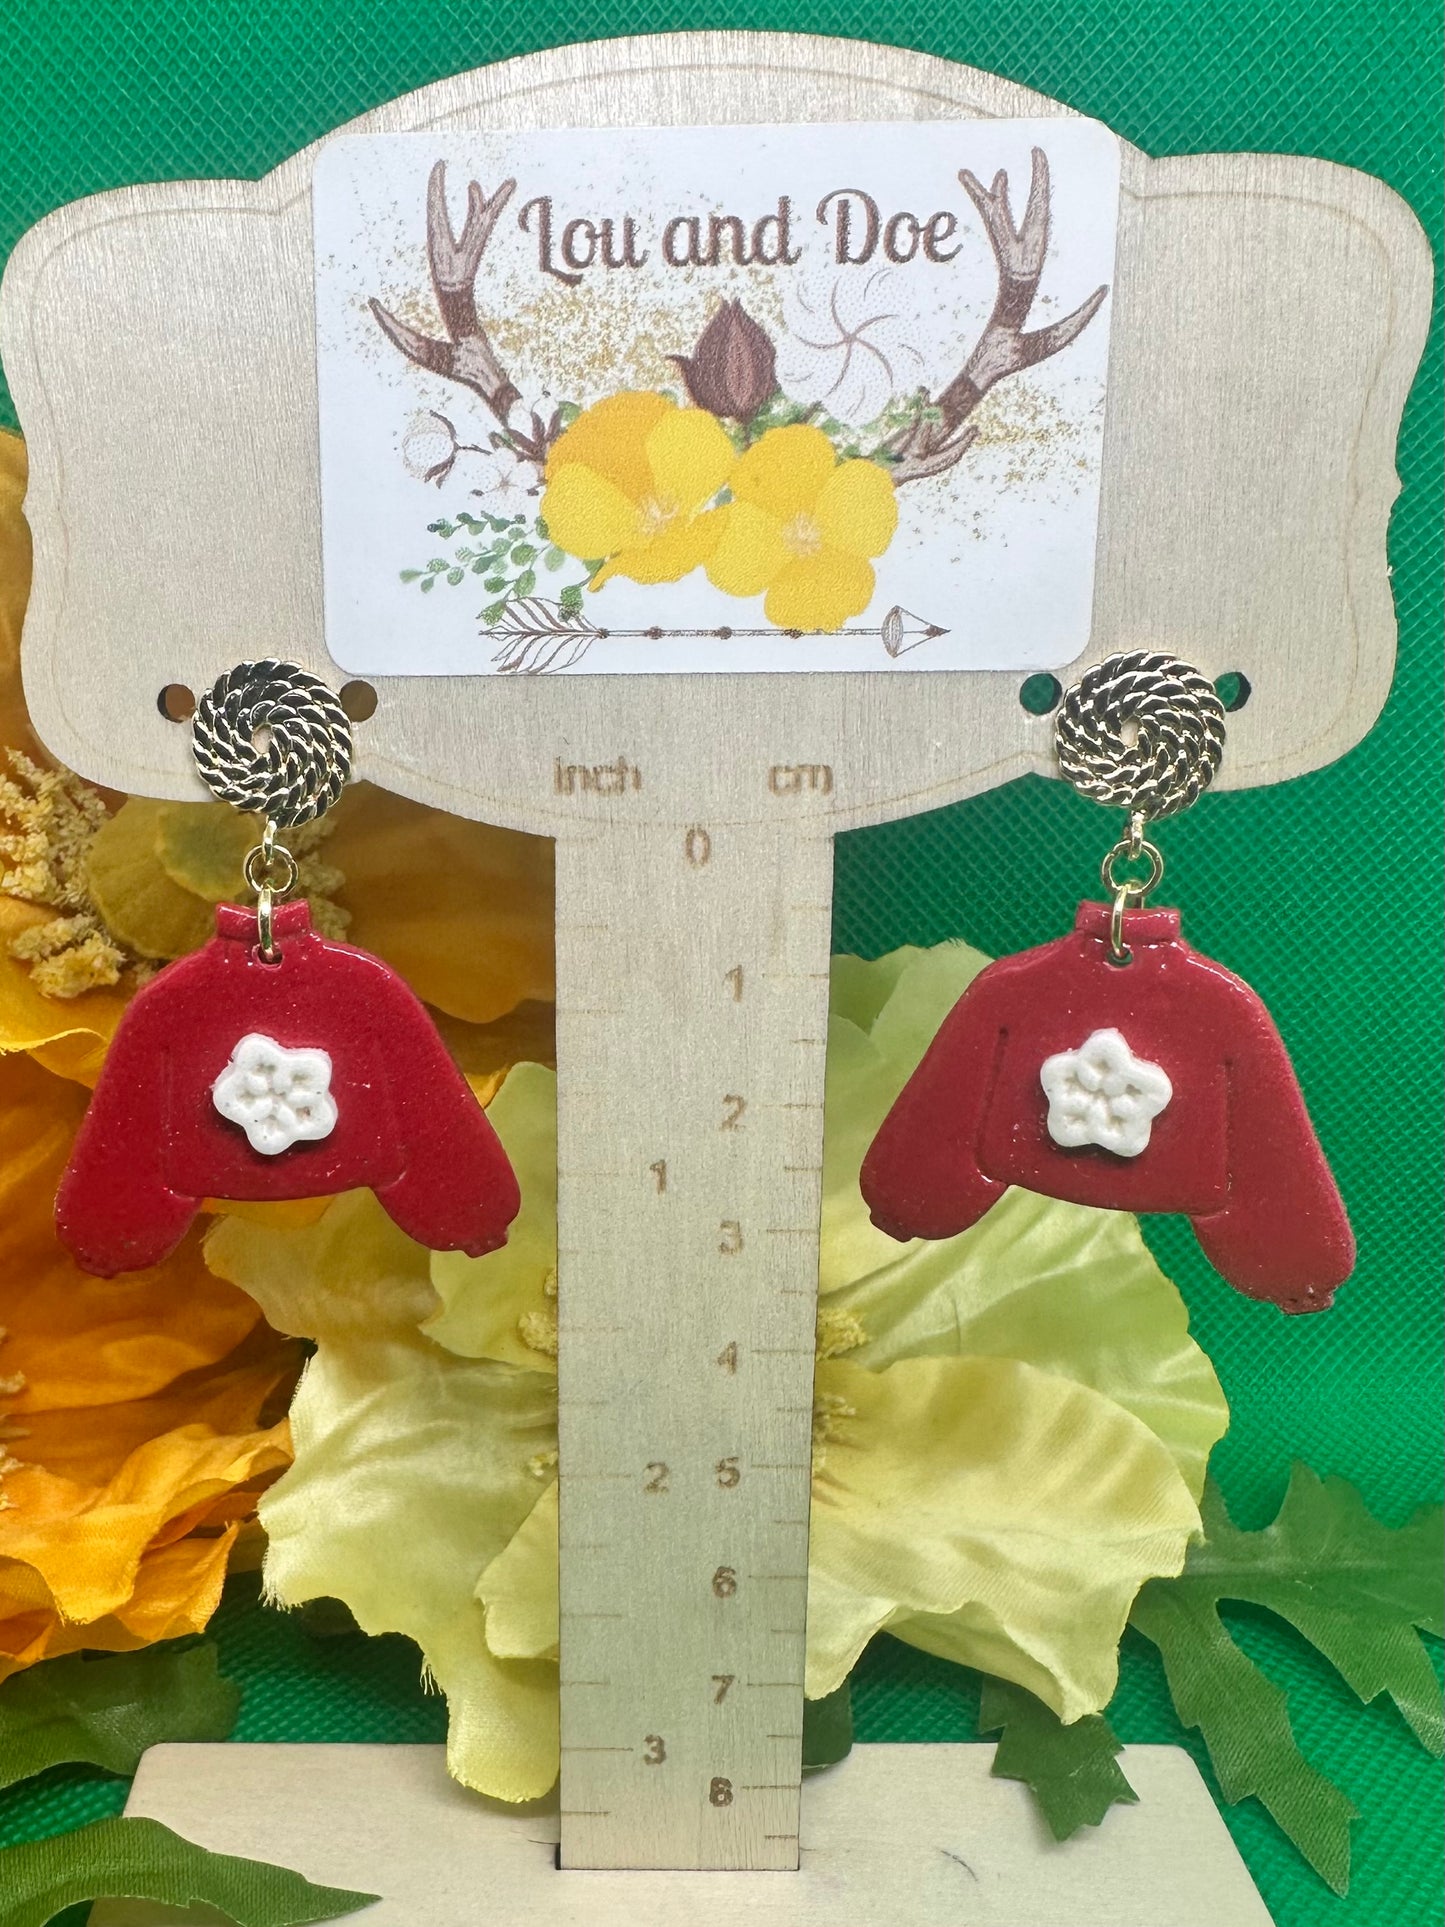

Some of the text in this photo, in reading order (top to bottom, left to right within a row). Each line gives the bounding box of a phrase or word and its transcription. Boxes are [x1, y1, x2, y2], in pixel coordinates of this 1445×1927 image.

[518, 188, 963, 287] Lou and Doe
[553, 756, 642, 796] inch
[768, 764, 833, 796] cm
[684, 827, 711, 867] 0
[723, 964, 743, 1002] 1
[719, 1093, 747, 1132] 2
[650, 1159, 667, 1194] 1
[718, 1219, 745, 1255] 3
[716, 1340, 738, 1375] 4
[643, 1461, 670, 1494] 2
[715, 1456, 741, 1489] 5
[712, 1565, 738, 1599] 6
[712, 1674, 736, 1705] 7
[643, 1734, 667, 1766] 3
